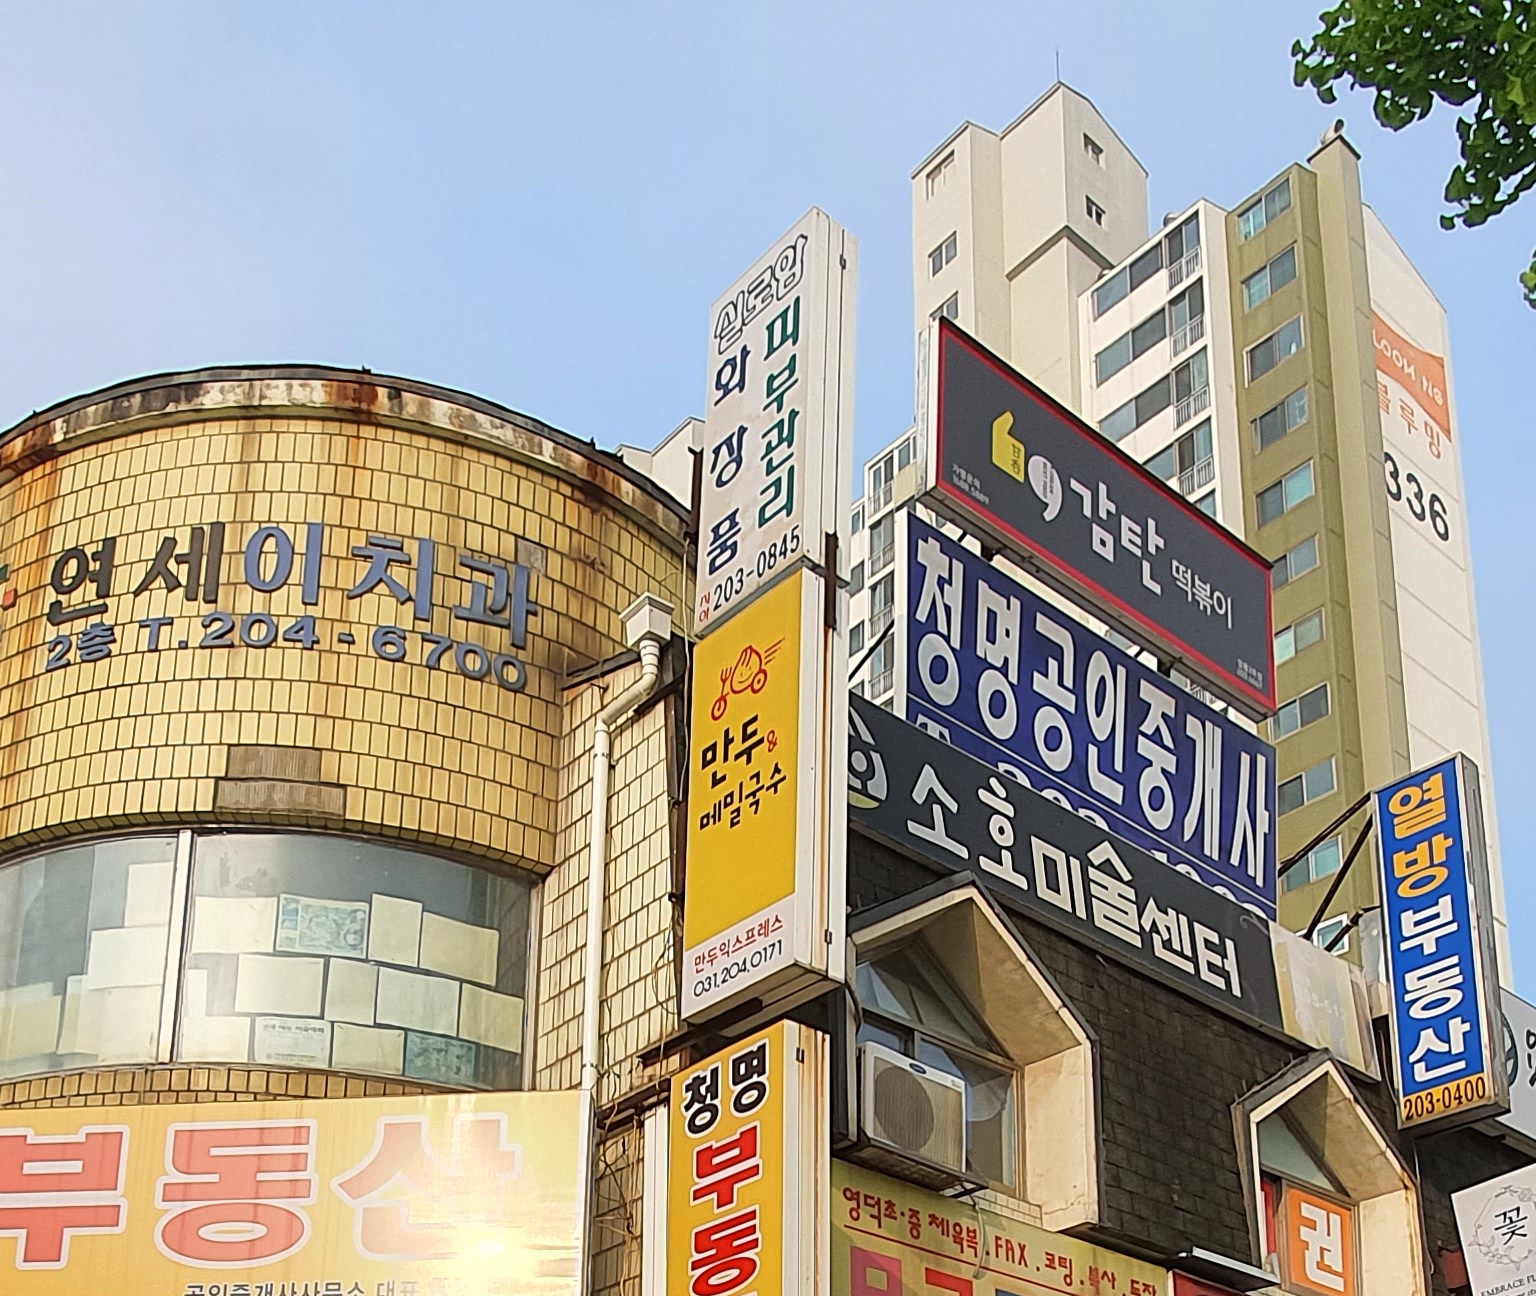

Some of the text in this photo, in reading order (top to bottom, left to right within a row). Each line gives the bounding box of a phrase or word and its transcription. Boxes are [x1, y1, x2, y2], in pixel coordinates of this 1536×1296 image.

[714, 234, 808, 355] 실로암
[756, 295, 801, 530] 피부관리
[704, 344, 750, 577] 화장품
[1384, 451, 1449, 541] 336
[47, 521, 538, 650] 연세이치과
[712, 528, 801, 612] 203-0845
[1070, 475, 1233, 629] 감탄 떡볶이
[45, 622, 117, 672] 2층
[701, 713, 766, 791] 만두
[914, 535, 1269, 889] 청명공인중개사
[699, 763, 787, 832] 메밀국수
[693, 913, 785, 976] 만두익스프레스
[693, 937, 785, 999] 031.204.0171
[1387, 771, 1472, 1082] 열방부동산
[681, 1043, 768, 1136] 청명
[1402, 1075, 1487, 1121] 203-0400
[928, 1213, 978, 1257] 체육복
[1300, 1201, 1346, 1290] 권
[1494, 1206, 1528, 1246] 꽃
